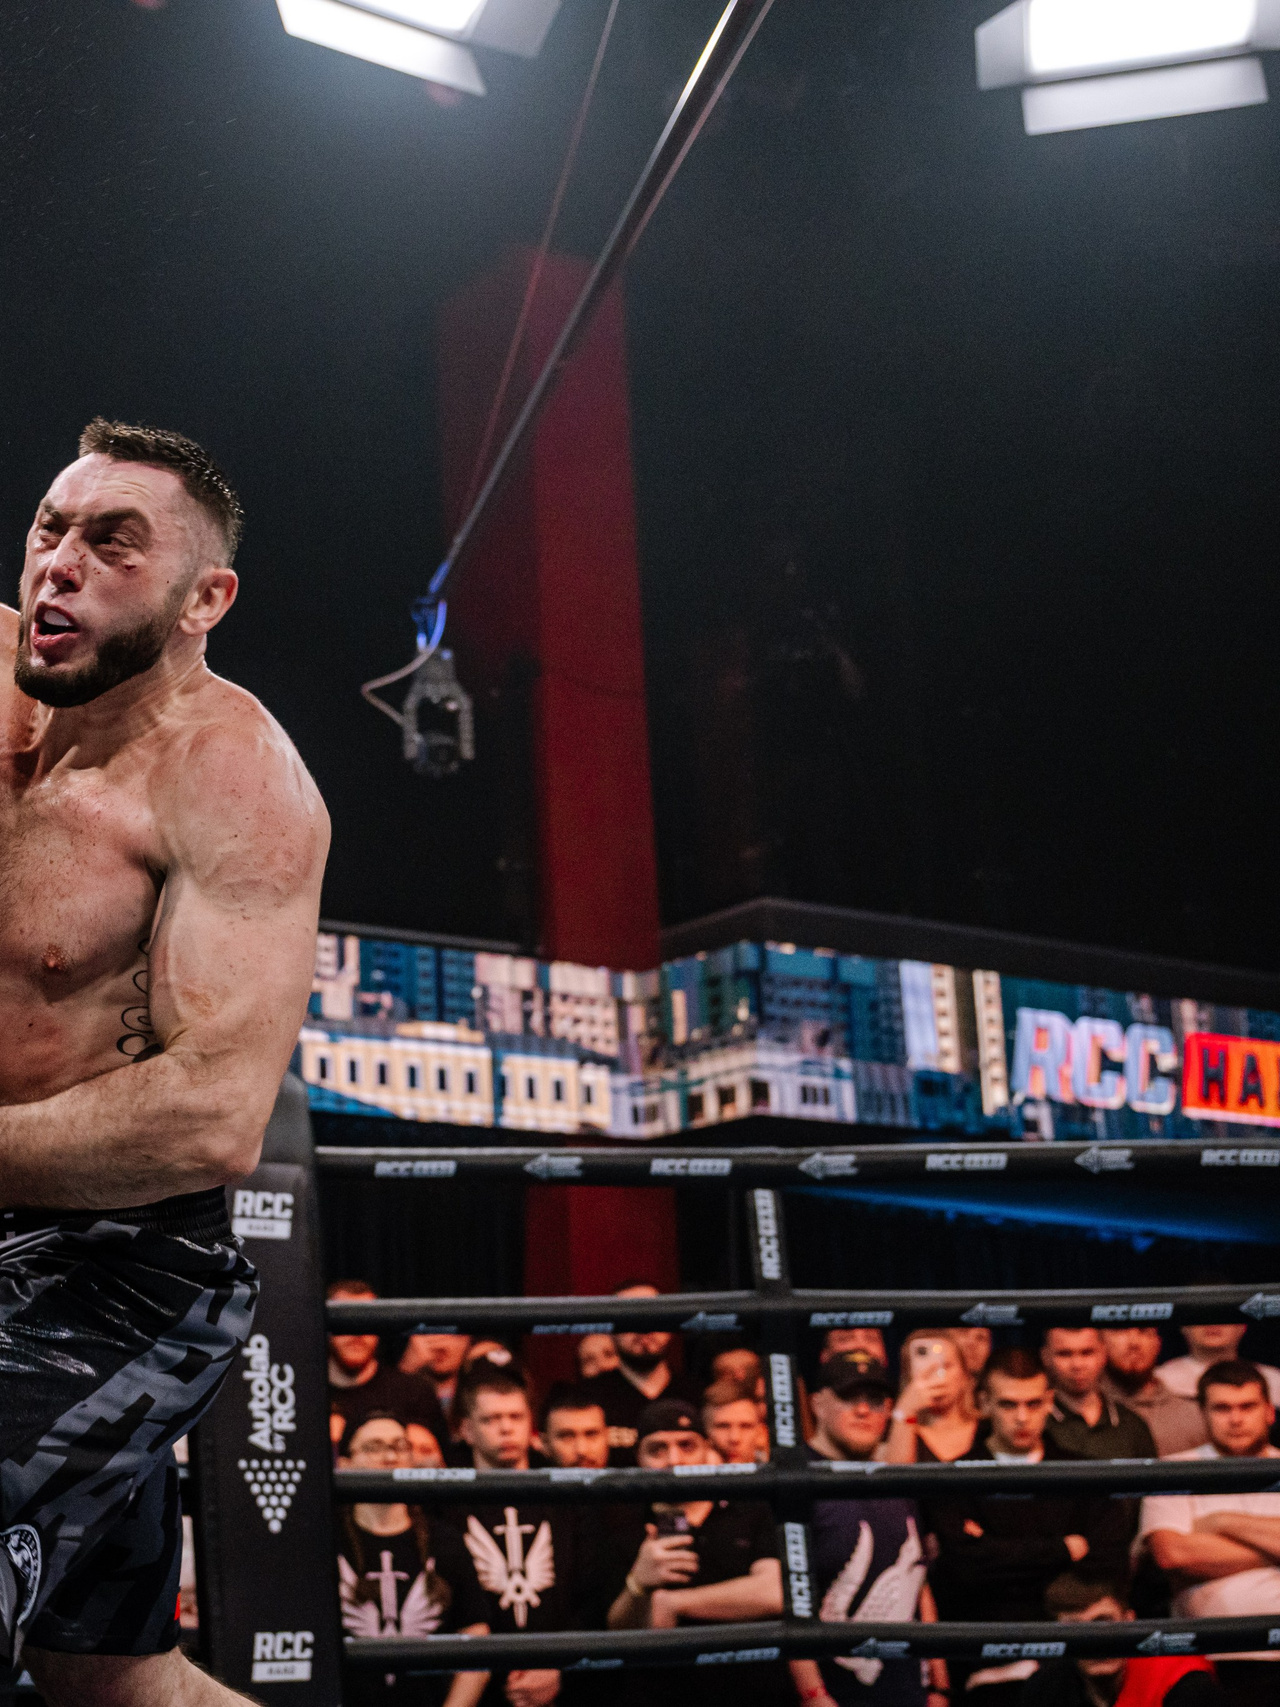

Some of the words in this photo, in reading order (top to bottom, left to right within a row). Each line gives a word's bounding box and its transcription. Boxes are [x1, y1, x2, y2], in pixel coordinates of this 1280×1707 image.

[1010, 1006, 1177, 1115] RCC
[1202, 1047, 1280, 1109] HA
[234, 1189, 294, 1219] RCC
[241, 1333, 273, 1453] Autolab
[271, 1362, 297, 1432] RCC
[253, 1630, 314, 1660] RCC
